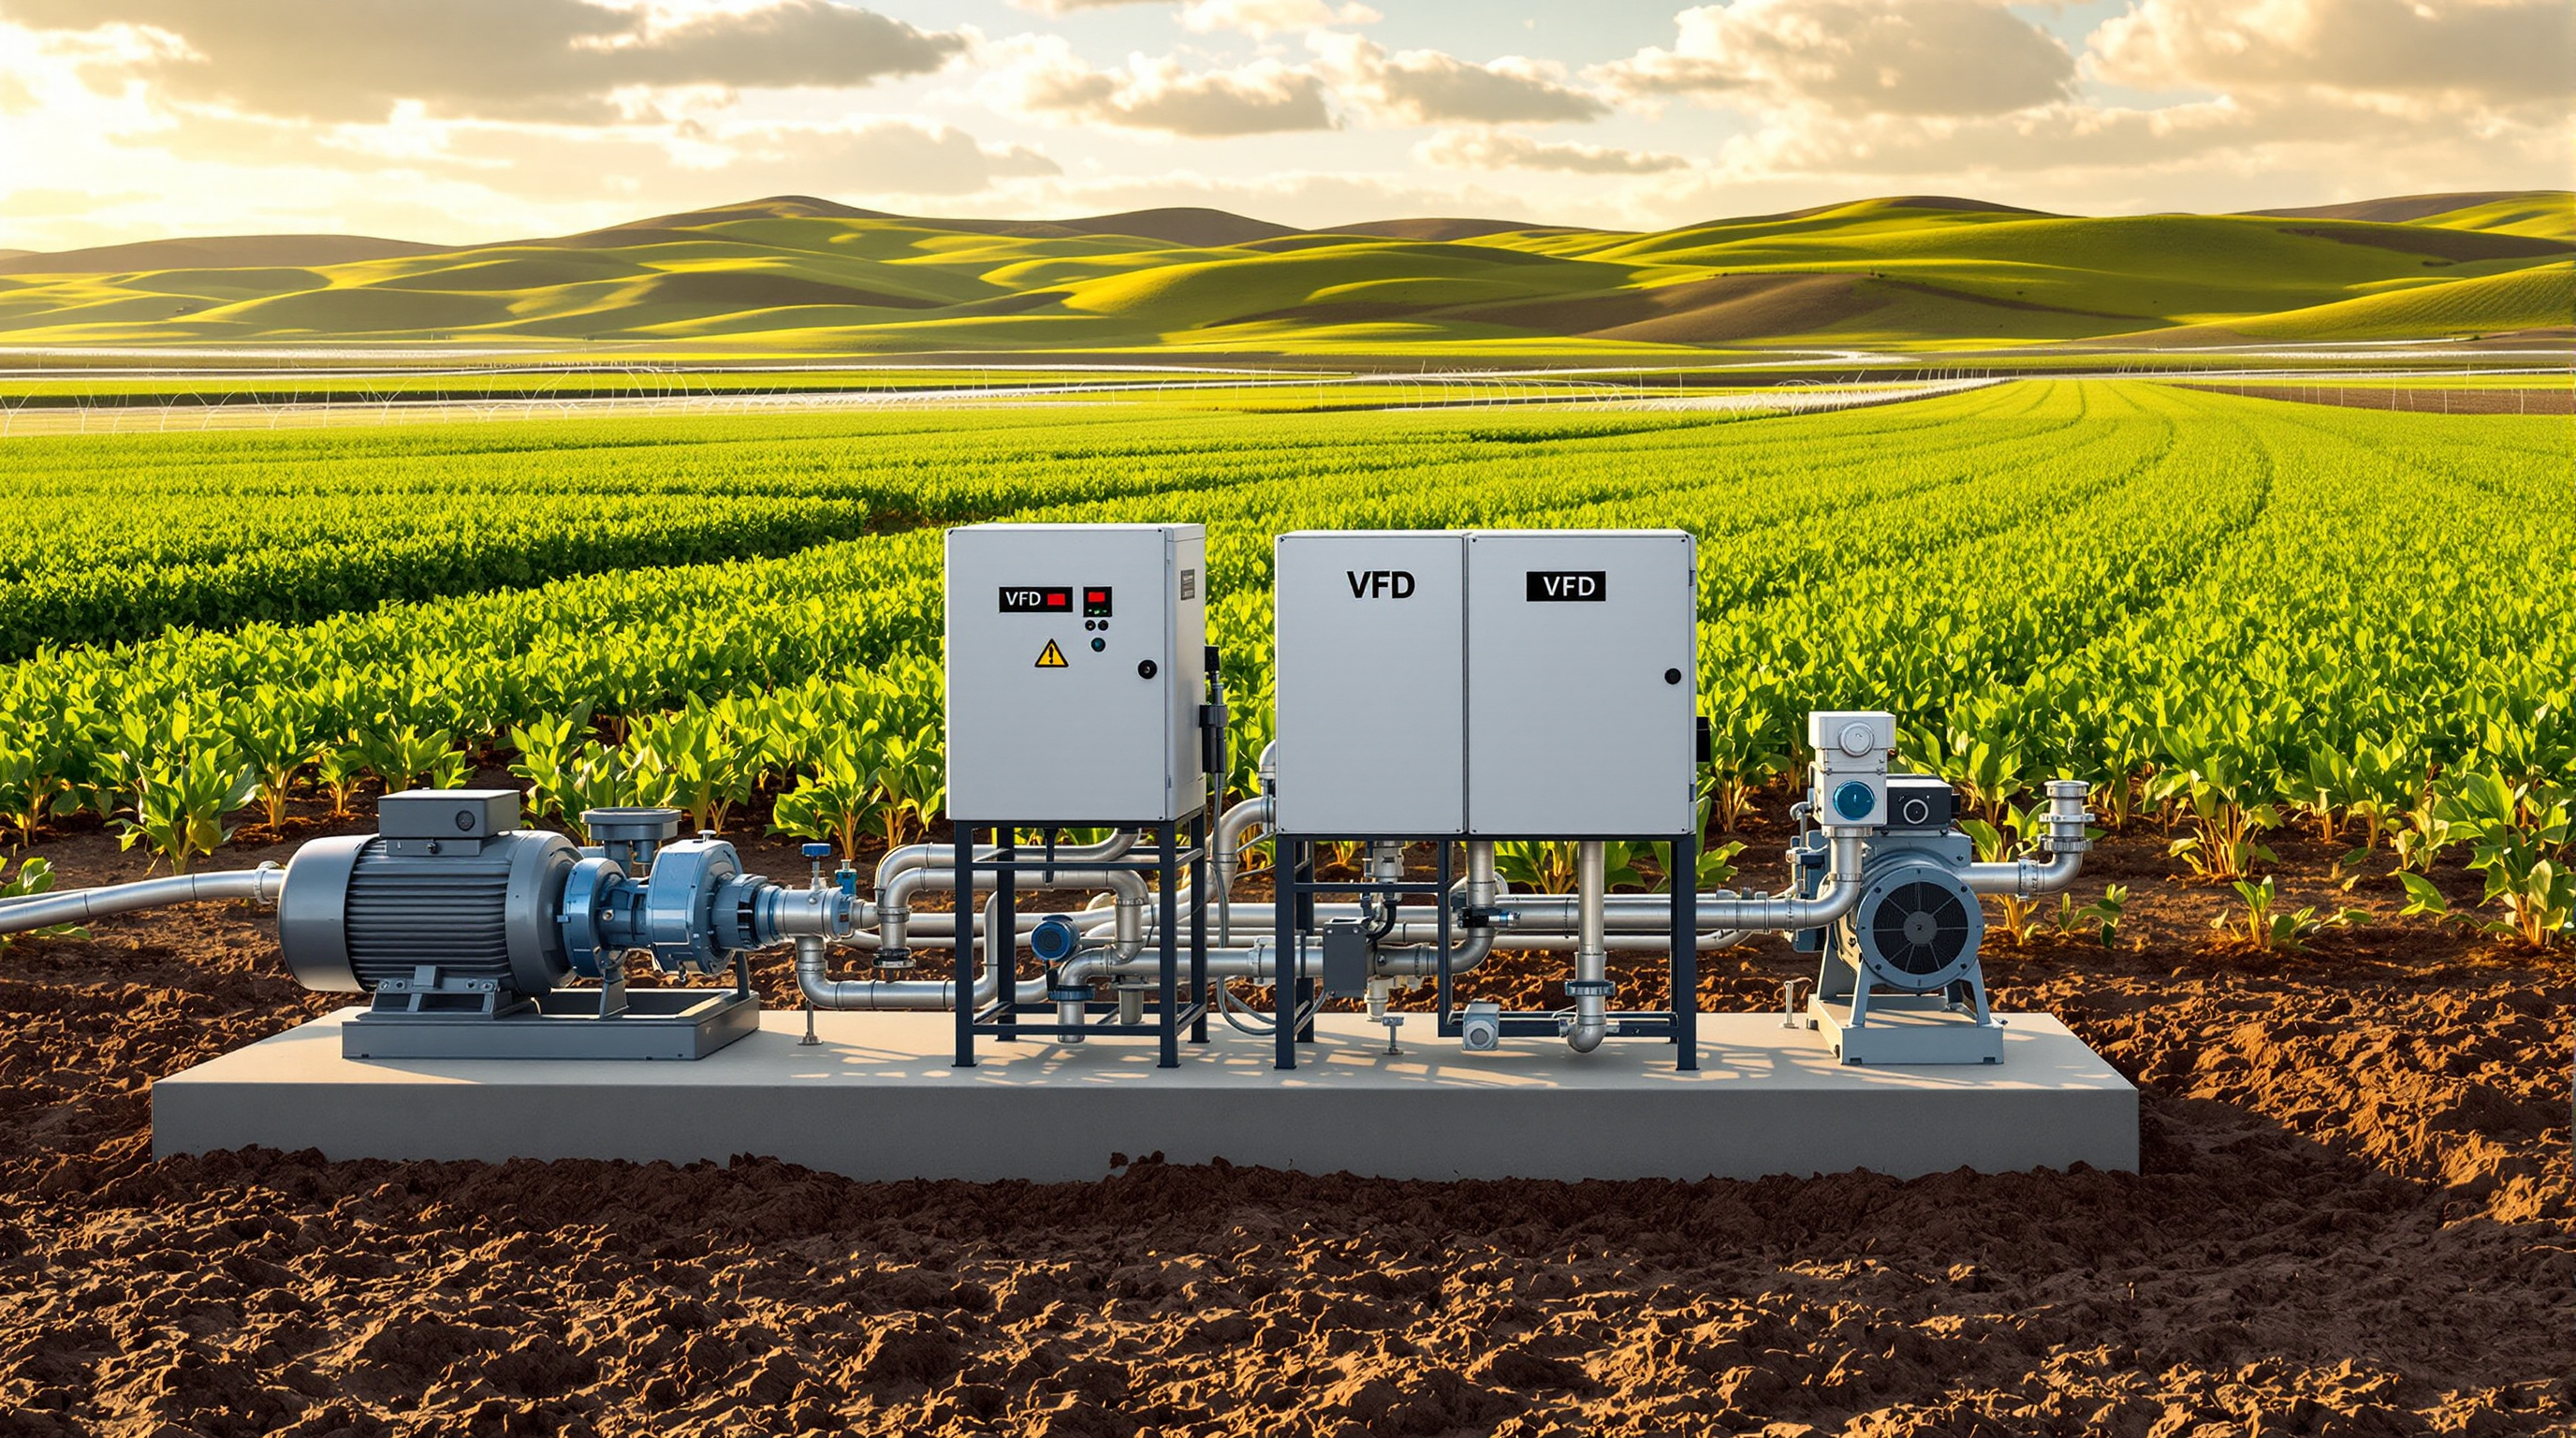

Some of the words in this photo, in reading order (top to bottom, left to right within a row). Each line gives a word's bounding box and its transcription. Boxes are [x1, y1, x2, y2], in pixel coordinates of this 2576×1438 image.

[1347, 570, 1415, 598] VFD
[1543, 576, 1596, 596] VFD
[1005, 591, 1042, 607] VFD
